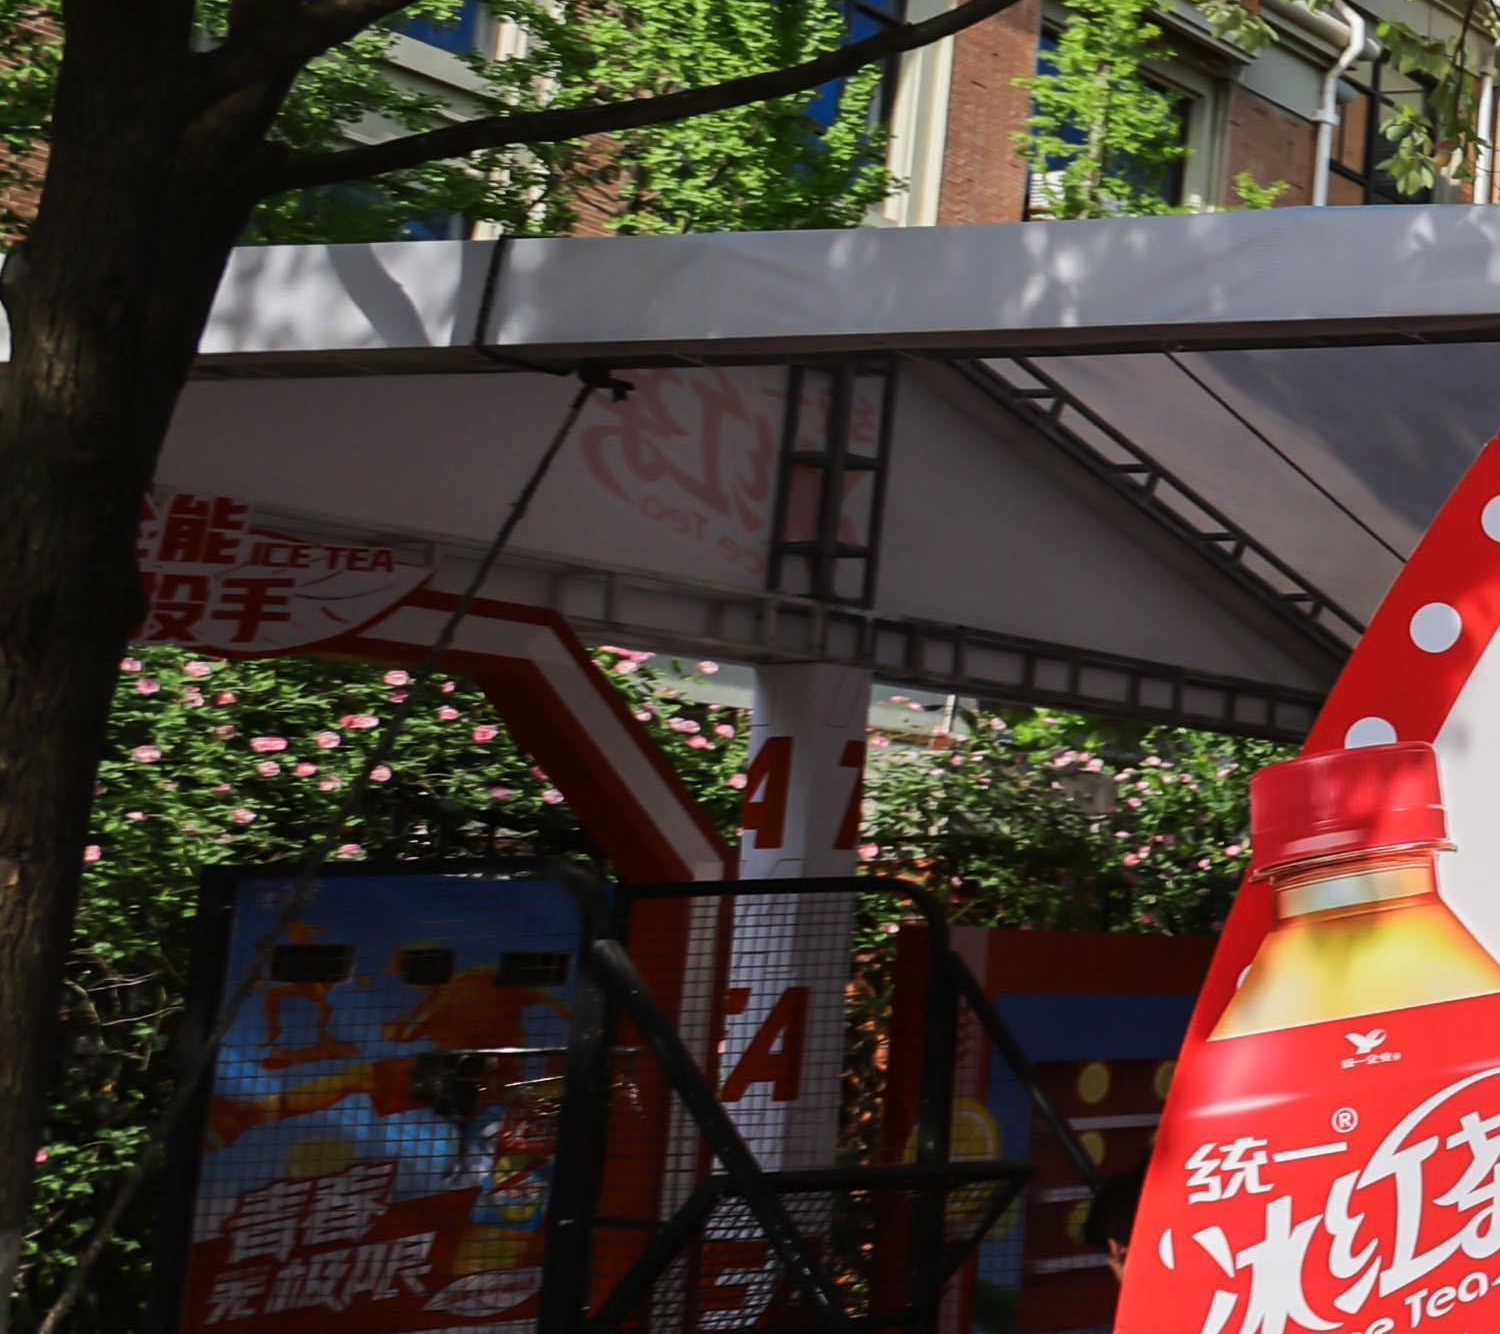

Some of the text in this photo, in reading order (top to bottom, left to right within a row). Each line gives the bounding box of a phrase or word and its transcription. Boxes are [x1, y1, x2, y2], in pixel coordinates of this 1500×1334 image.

[251, 541, 395, 573] ICE TEA
[1185, 1136, 1348, 1204] 统一
[224, 1162, 395, 1266] 青春
[1403, 1268, 1492, 1329] Tea
